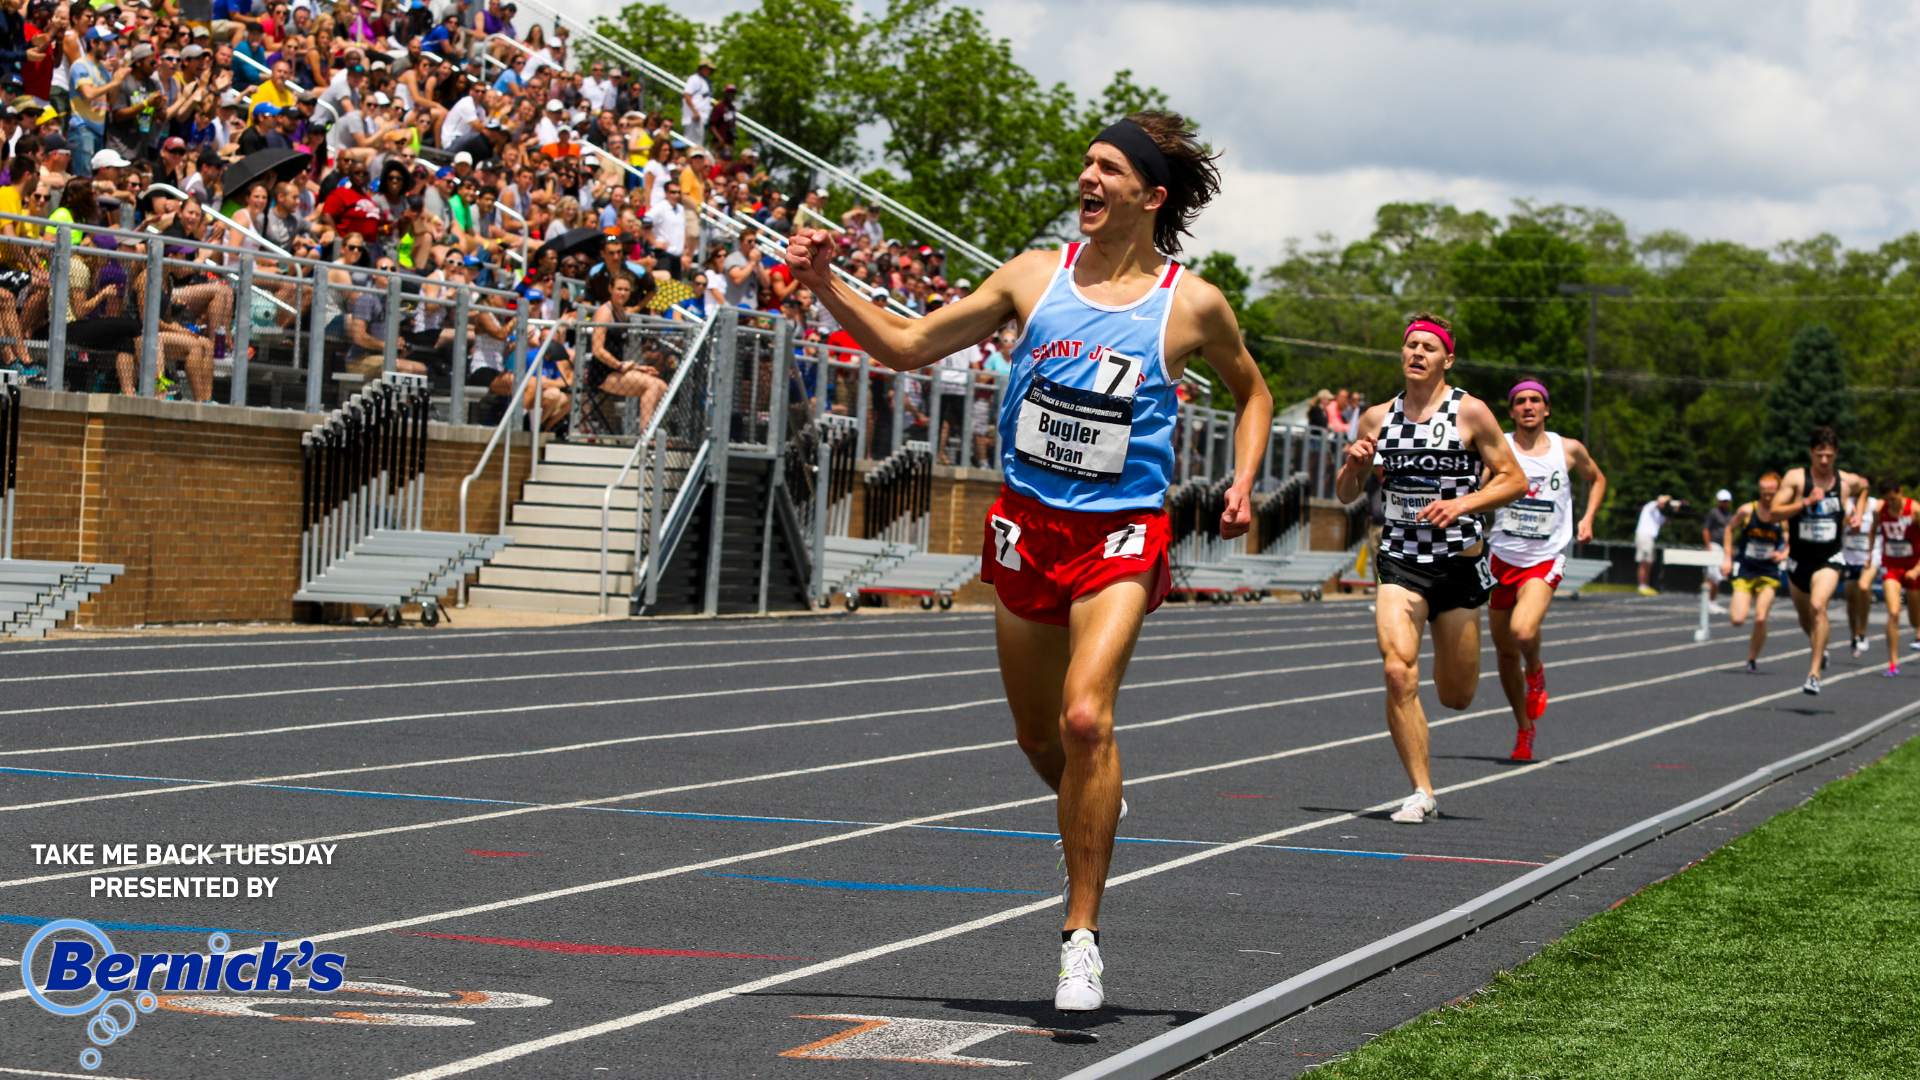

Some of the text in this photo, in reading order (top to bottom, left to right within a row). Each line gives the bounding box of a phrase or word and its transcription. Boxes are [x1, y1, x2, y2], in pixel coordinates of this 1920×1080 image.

[1031, 340, 1083, 361] SAINT
[1108, 355, 1132, 395] 7
[1041, 394, 1055, 406] TRACK
[1059, 401, 1075, 411] FIELD
[1075, 405, 1123, 418] CHAMPIONSHIPS
[1038, 412, 1101, 445] Bugler
[1431, 422, 1446, 447] 9
[1045, 440, 1083, 465] Ryan
[1550, 470, 1560, 491] 6
[1391, 493, 1436, 509] Carpente
[995, 519, 1013, 562] 7
[1480, 561, 1492, 586] 9
